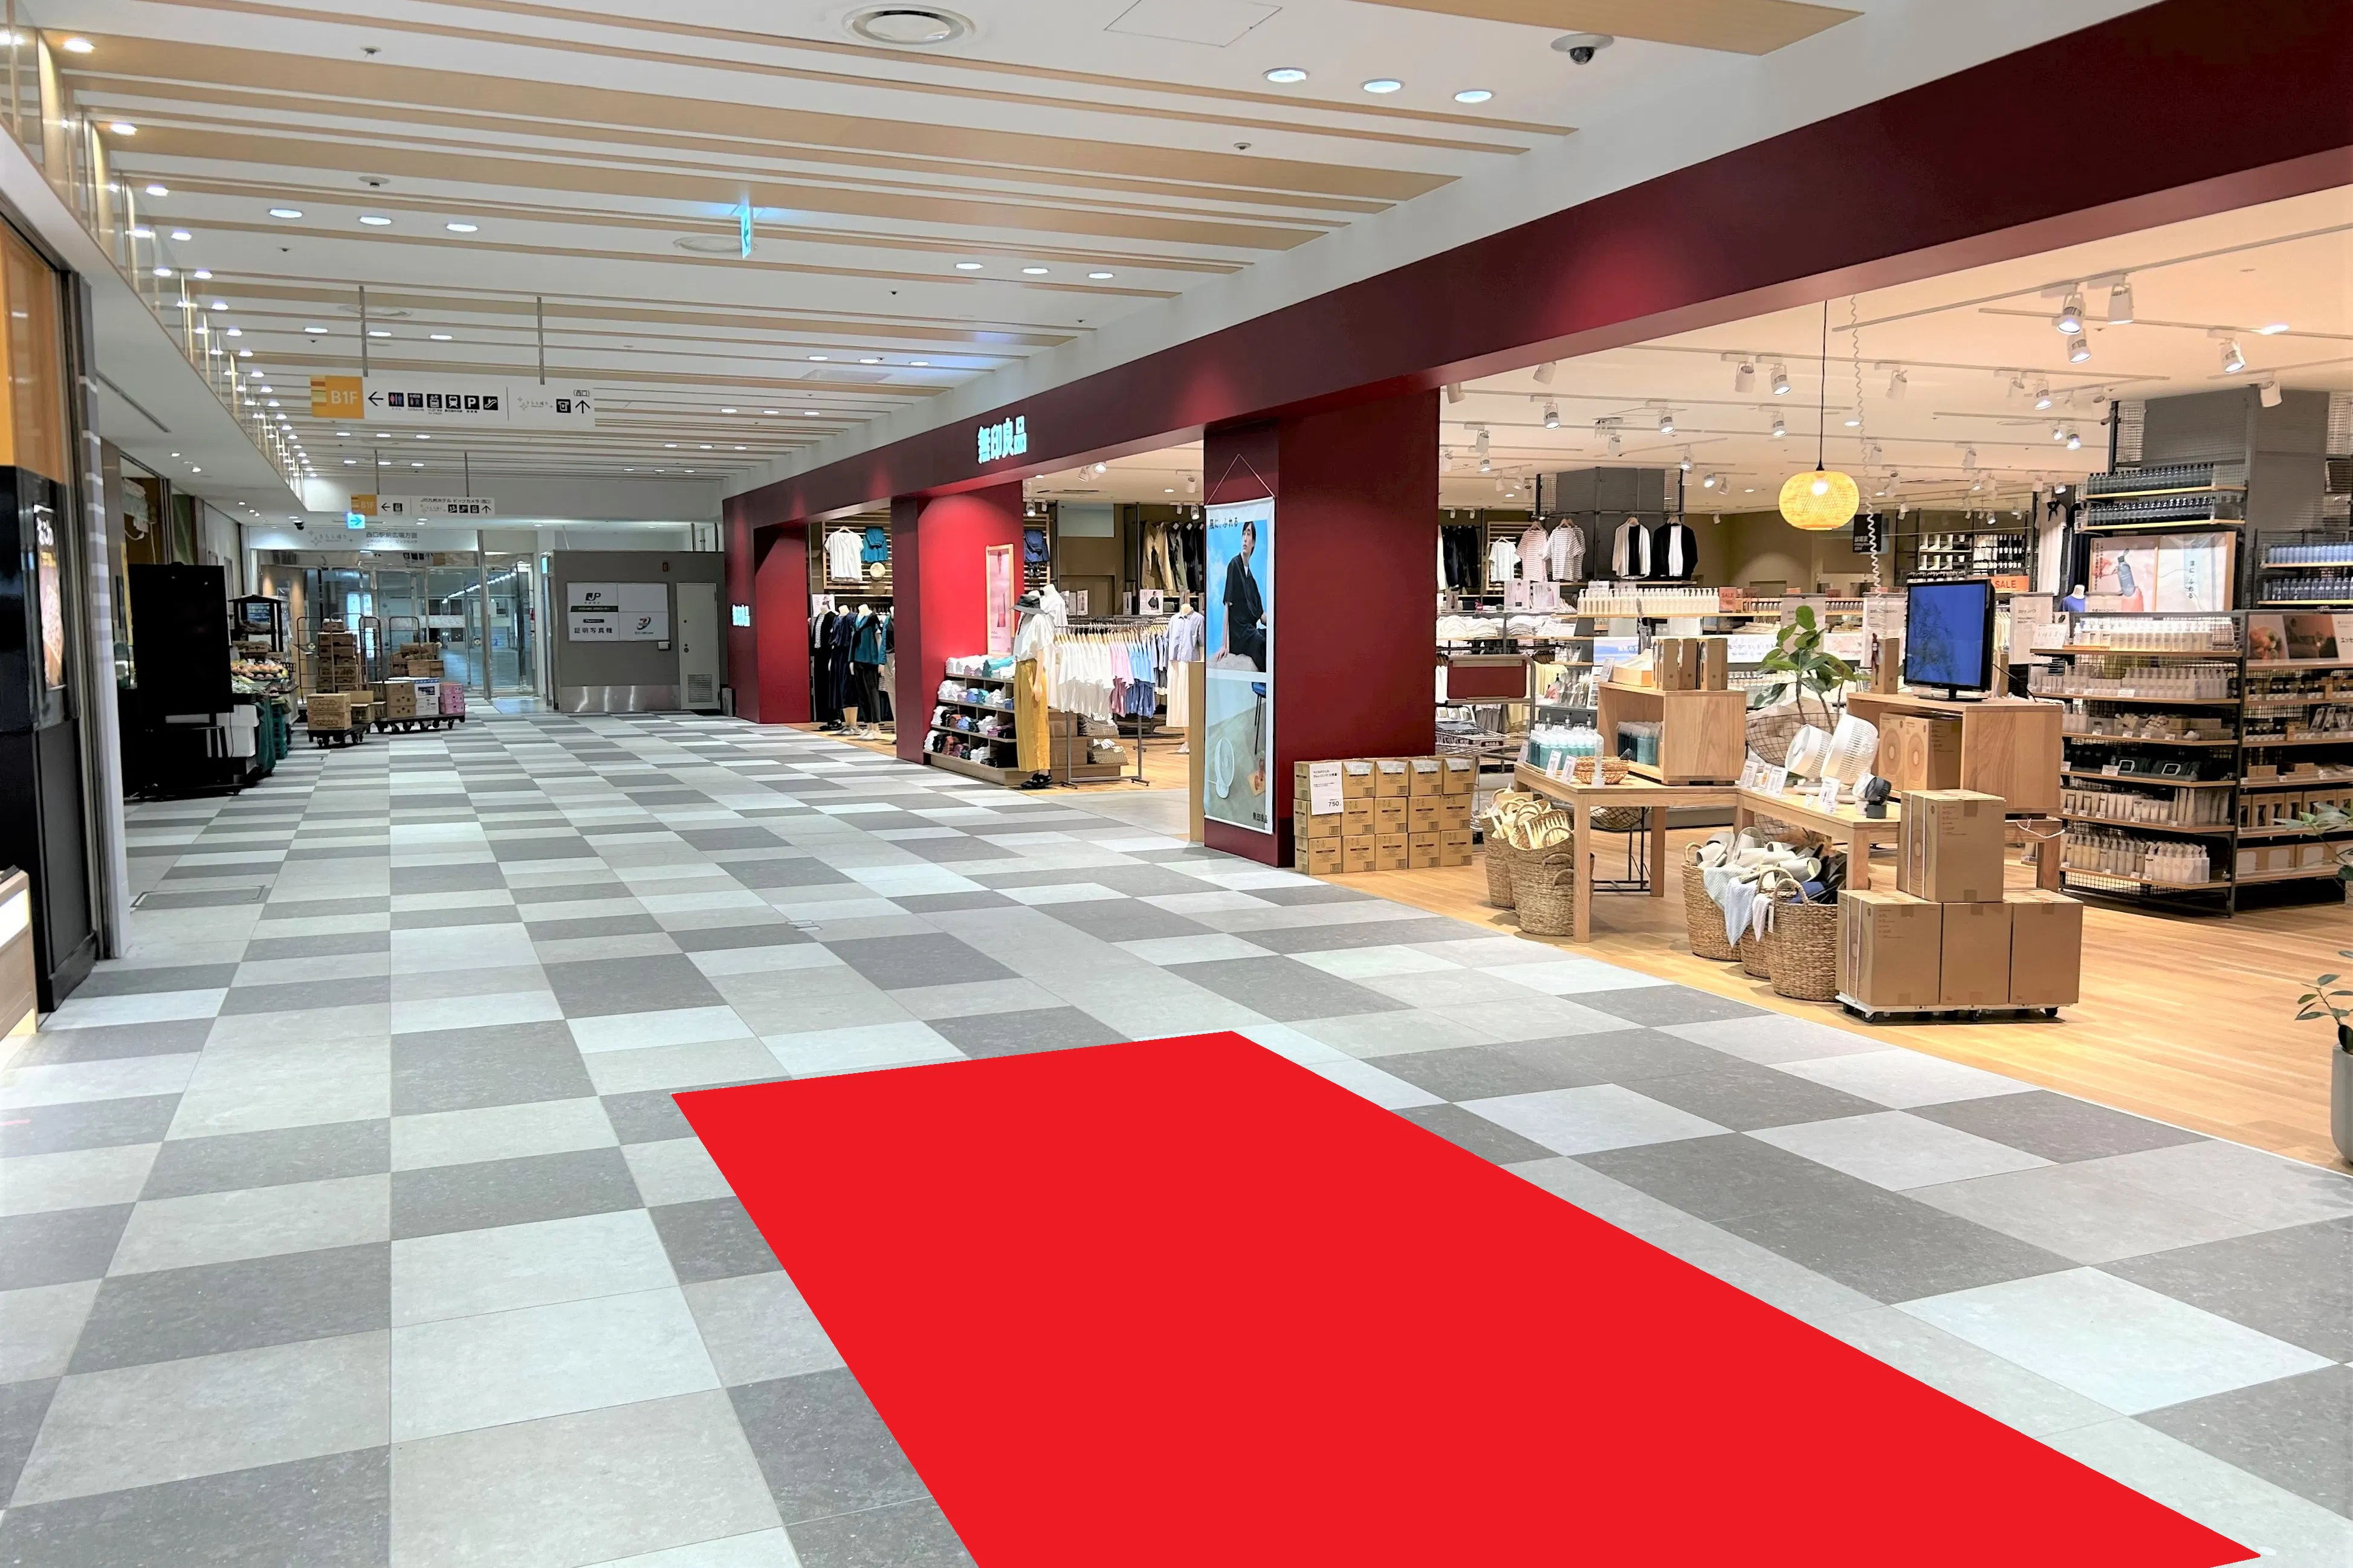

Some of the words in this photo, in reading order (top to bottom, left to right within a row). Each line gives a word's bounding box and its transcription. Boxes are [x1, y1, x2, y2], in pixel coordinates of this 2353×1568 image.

[331, 390, 358, 404] B1F
[977, 415, 1027, 464] 無印良品
